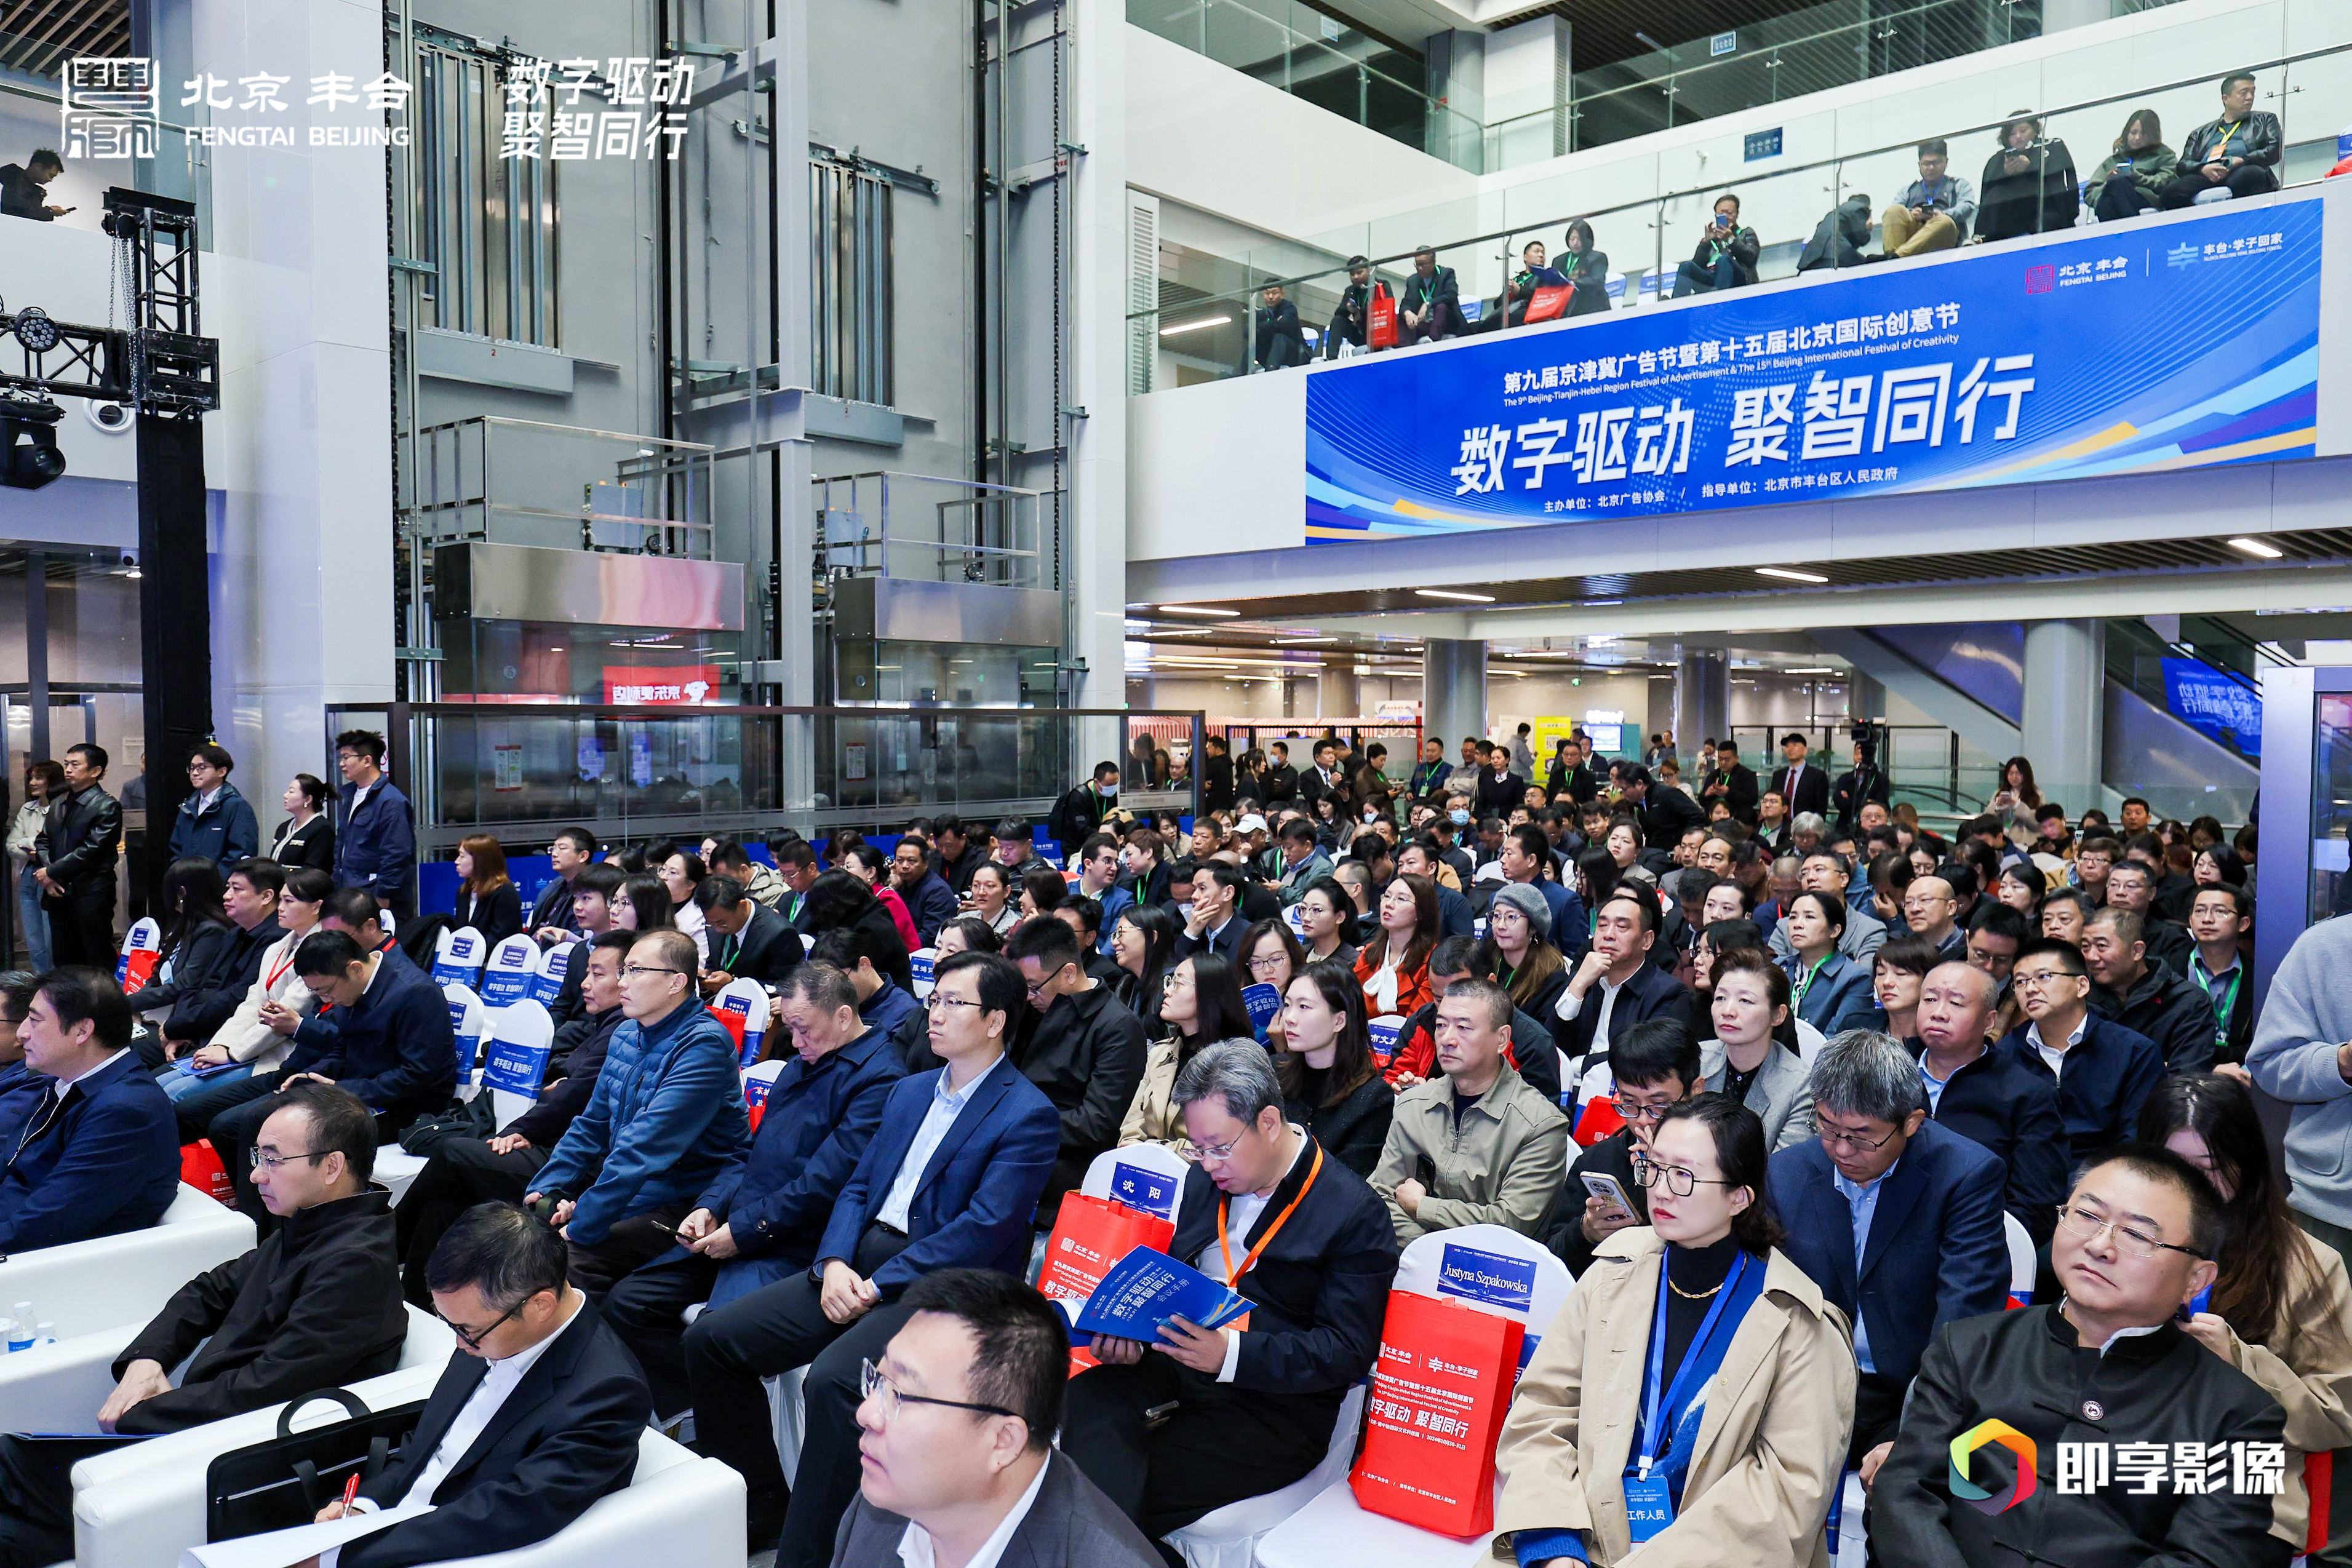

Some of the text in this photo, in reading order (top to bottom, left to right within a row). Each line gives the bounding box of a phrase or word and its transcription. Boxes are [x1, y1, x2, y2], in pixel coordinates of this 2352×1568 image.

[2059, 274, 2093, 287] FENGTAI
[2095, 269, 2127, 282] BEIJING
[1504, 301, 1961, 395] 第九届京津冀广告节暨第十五届北京国际创意节
[1504, 398, 1518, 407] The
[1528, 385, 1602, 405] Beijing-Tianjin-Hebei
[1603, 381, 1630, 394] Region
[1630, 377, 1660, 389] Festival
[1660, 375, 1670, 384] of
[1670, 368, 1729, 383] Advertisement
[1729, 365, 1737, 374] &
[1739, 363, 1755, 373] The
[1773, 356, 1803, 369] Beijing
[1804, 346, 1863, 364] International
[1864, 343, 1900, 355] Festival
[1902, 341, 1911, 349] of
[1915, 333, 1959, 348] Creativity
[1451, 353, 2036, 496] 数字驱动 聚智同行
[1131, 1273, 1176, 1308] 聚智同行
[1157, 1278, 1190, 1302] 会议手册
[1444, 1264, 1528, 1293] Justyna Szpakowska
[1112, 1275, 1155, 1317] 数字驱动
[1387, 1392, 1400, 1401] Beijing
[1399, 1395, 1424, 1406] International
[1442, 1406, 1460, 1415] Creativity
[1414, 1409, 1470, 1439] 聚智同行
[1627, 1509, 1666, 1521] 工作人员
